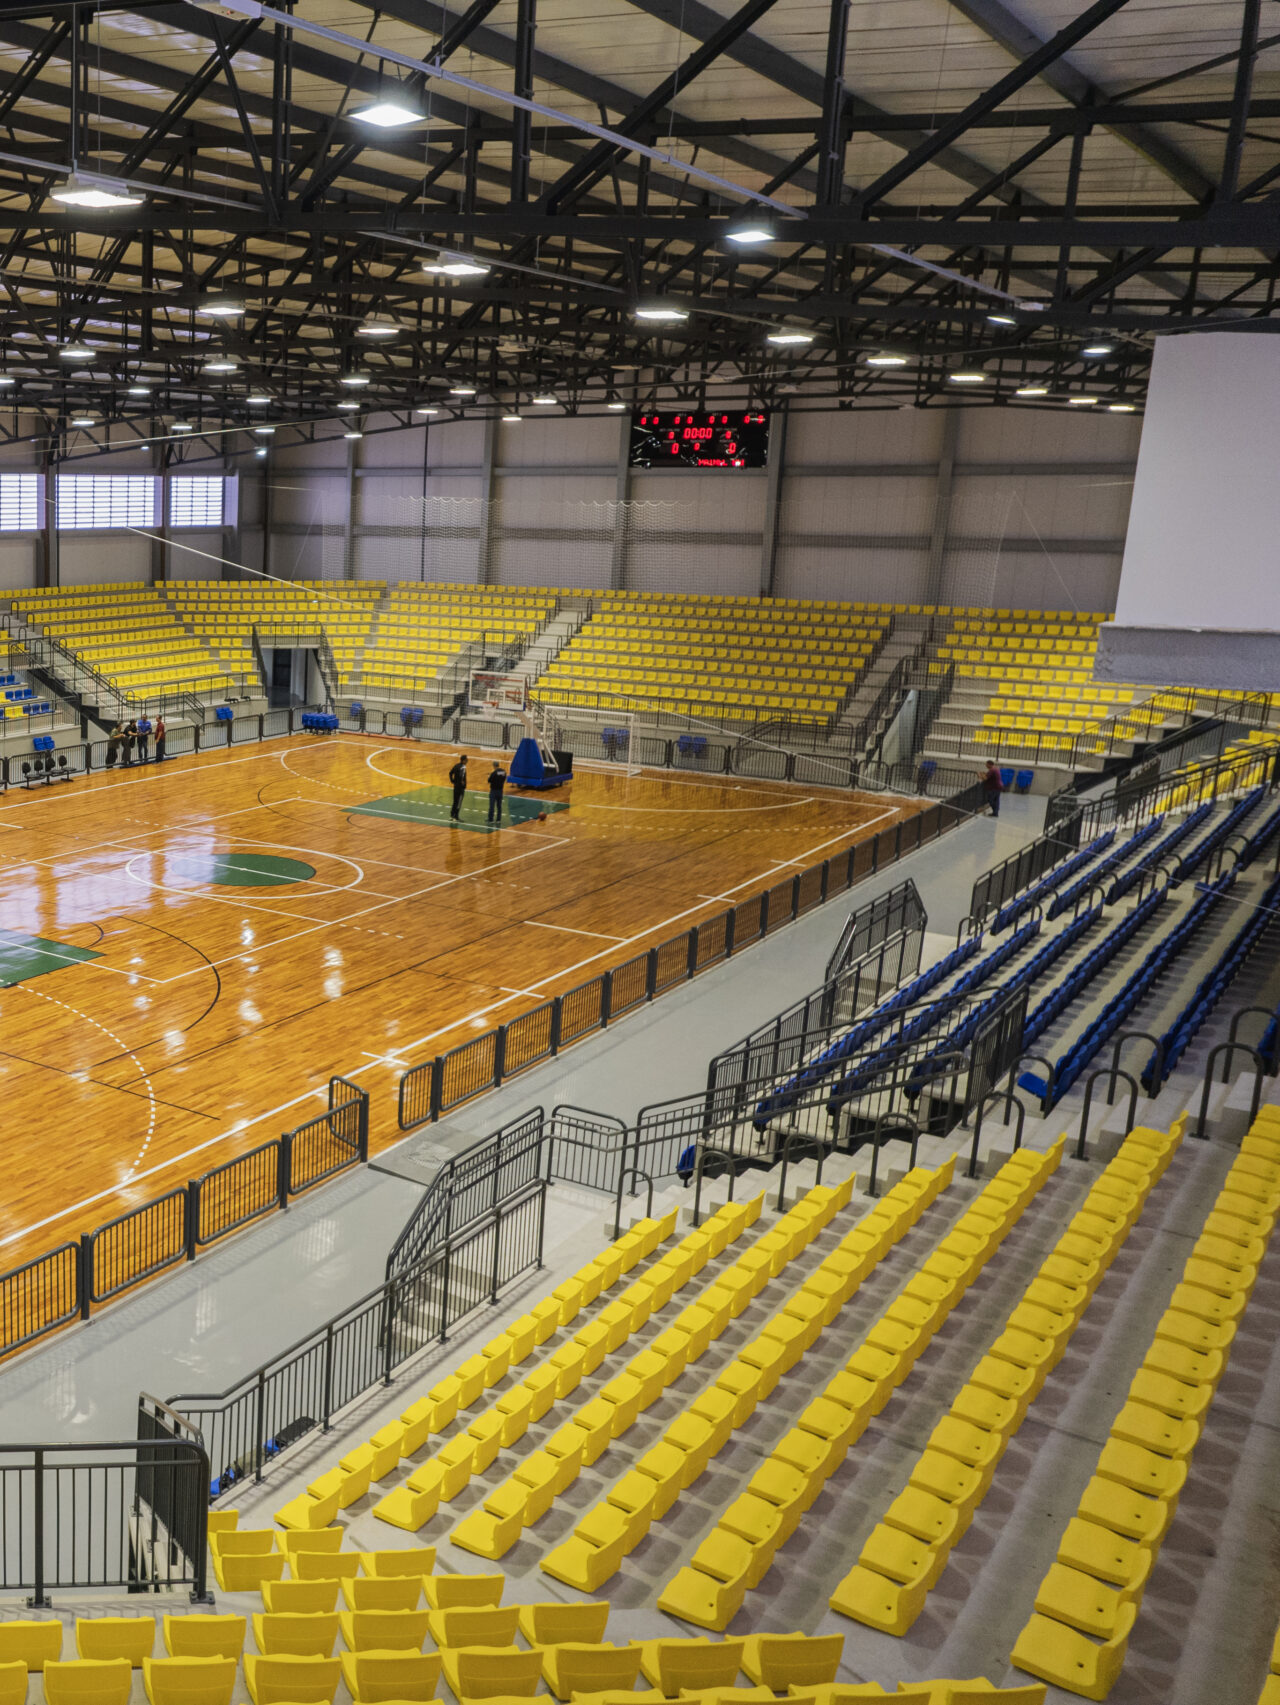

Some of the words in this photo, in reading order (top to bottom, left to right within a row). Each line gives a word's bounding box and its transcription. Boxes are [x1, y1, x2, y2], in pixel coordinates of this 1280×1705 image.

[682, 428, 712, 440] 00:00
[670, 443, 680, 454] 0
[728, 443, 736, 454] 0
